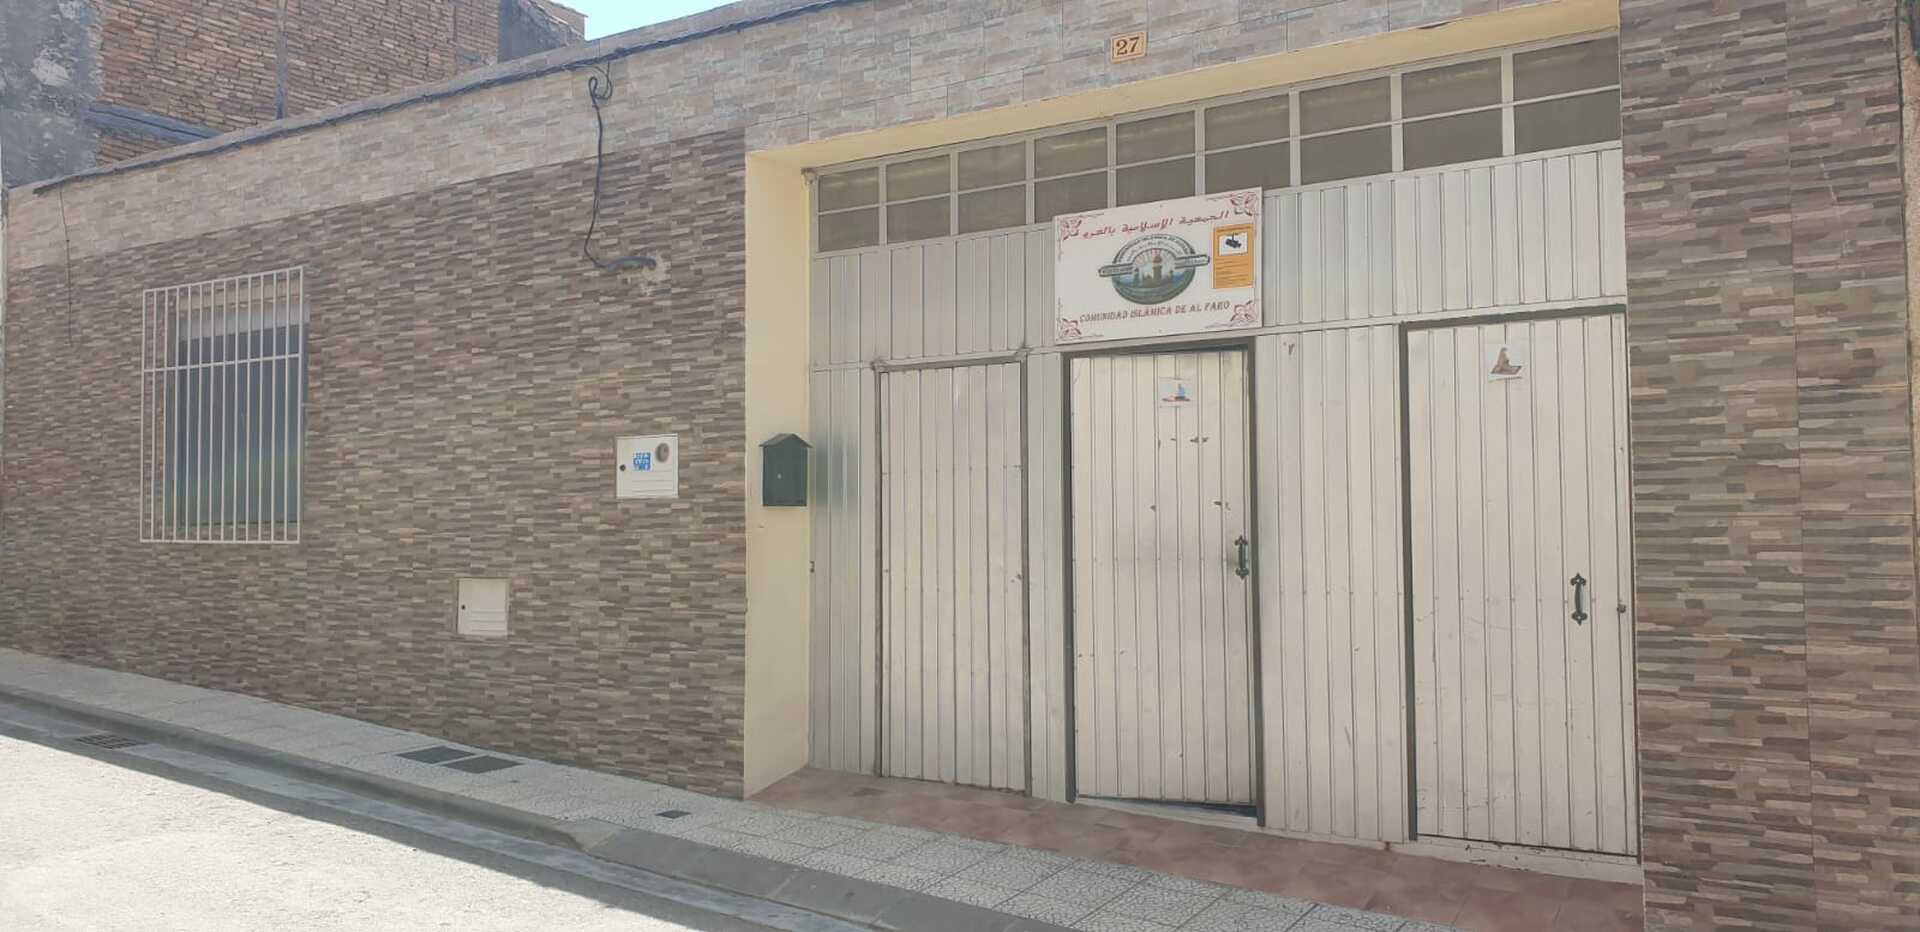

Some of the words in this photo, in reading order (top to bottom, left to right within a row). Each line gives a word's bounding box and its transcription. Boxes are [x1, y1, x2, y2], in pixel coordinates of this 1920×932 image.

[1115, 36, 1140, 55] 27
[1080, 310, 1128, 323] COMUNIDAD
[1175, 304, 1186, 314] DE
[1189, 303, 1202, 312] AL
[1204, 300, 1230, 311] FARO
